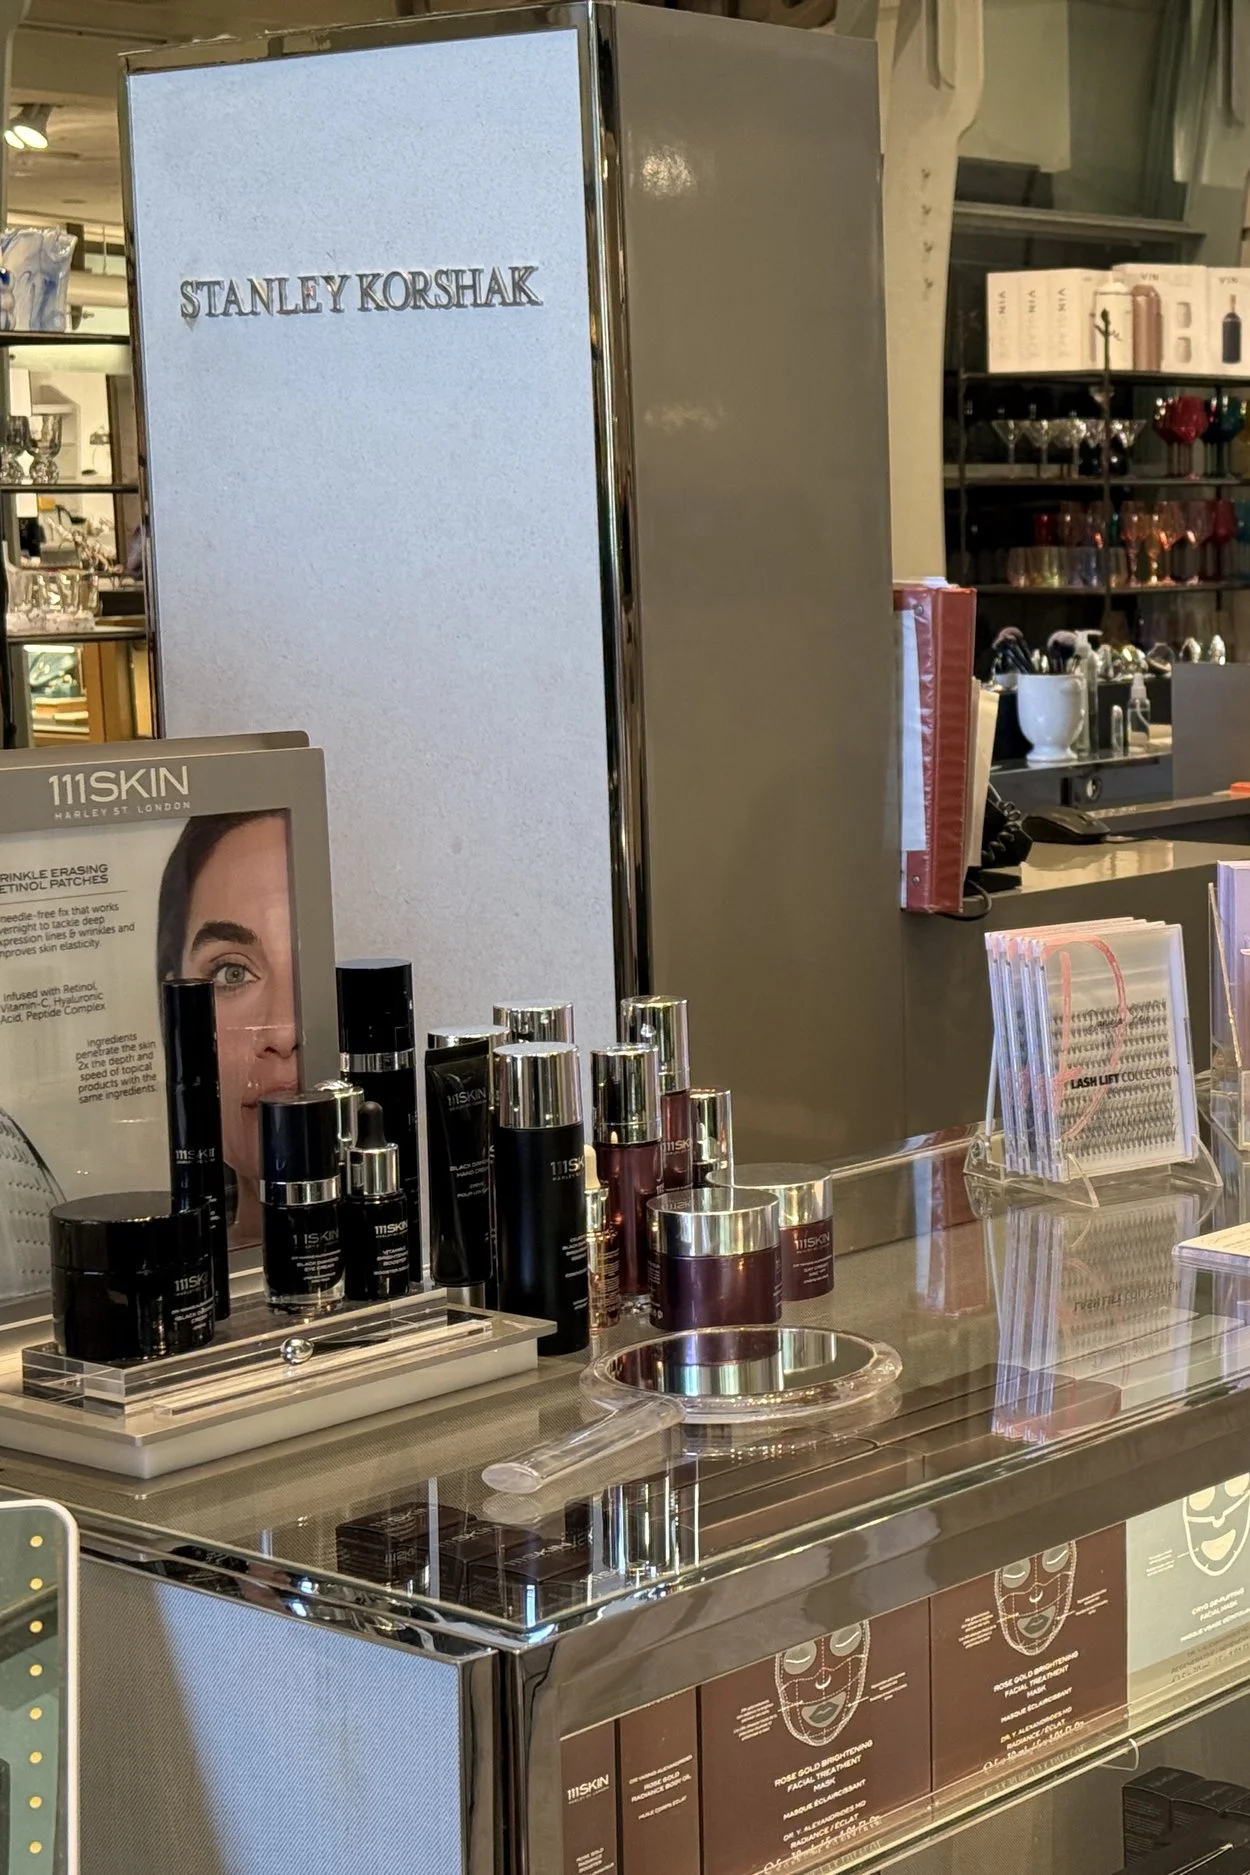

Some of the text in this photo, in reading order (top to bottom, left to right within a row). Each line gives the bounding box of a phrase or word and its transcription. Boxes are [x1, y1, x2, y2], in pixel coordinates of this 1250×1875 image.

[180, 266, 544, 319] STANLEY KORSHAK
[49, 765, 190, 806] 111SKIN
[54, 801, 191, 821] HARLEY ST LONDON
[0, 863, 109, 883] RINKLE ERASING
[0, 873, 109, 894] ETINOL PATCHES
[1, 902, 120, 925] needle-free fix that works
[0, 915, 105, 937] vernight to tackle deep
[0, 922, 135, 948] xpression lines & wrinkles and
[39, 944, 58, 954] skin
[1, 991, 104, 1014] Vitamin-C, Hyaluronic
[40, 986, 61, 998] with
[0, 1013, 24, 1026] Acid,
[26, 1006, 62, 1023] Peptide
[75, 1039, 157, 1062] penetrate the skin
[78, 1050, 155, 1071] 2x the depth and
[79, 1061, 153, 1082] speed of topical
[1071, 1076, 1098, 1090] LASH
[1099, 1073, 1120, 1085] LIFT
[1121, 1066, 1180, 1083] COLLECTION
[78, 1072, 157, 1093] products with the
[79, 1092, 104, 1104] same
[661, 1138, 692, 1152] 111SK
[550, 1156, 585, 1176] 111SK
[292, 1230, 340, 1246] 11SKIN
[994, 1650, 1079, 1693] ROSE GOLD BRIGHTENING
[1004, 1663, 1070, 1699] FACIAL TREATMENT
[1026, 1684, 1047, 1699] MASK
[1006, 1730, 1040, 1750] RADIANCE
[774, 1739, 874, 1787] ROSE GOLD BRIGHTENING
[787, 1754, 862, 1793] FACIAL TREATMENT
[567, 1773, 610, 1801] 111SKIN
[813, 1777, 836, 1793] MASK
[783, 1802, 814, 1821] MASQUE
[790, 1828, 830, 1850] RADIANCE
